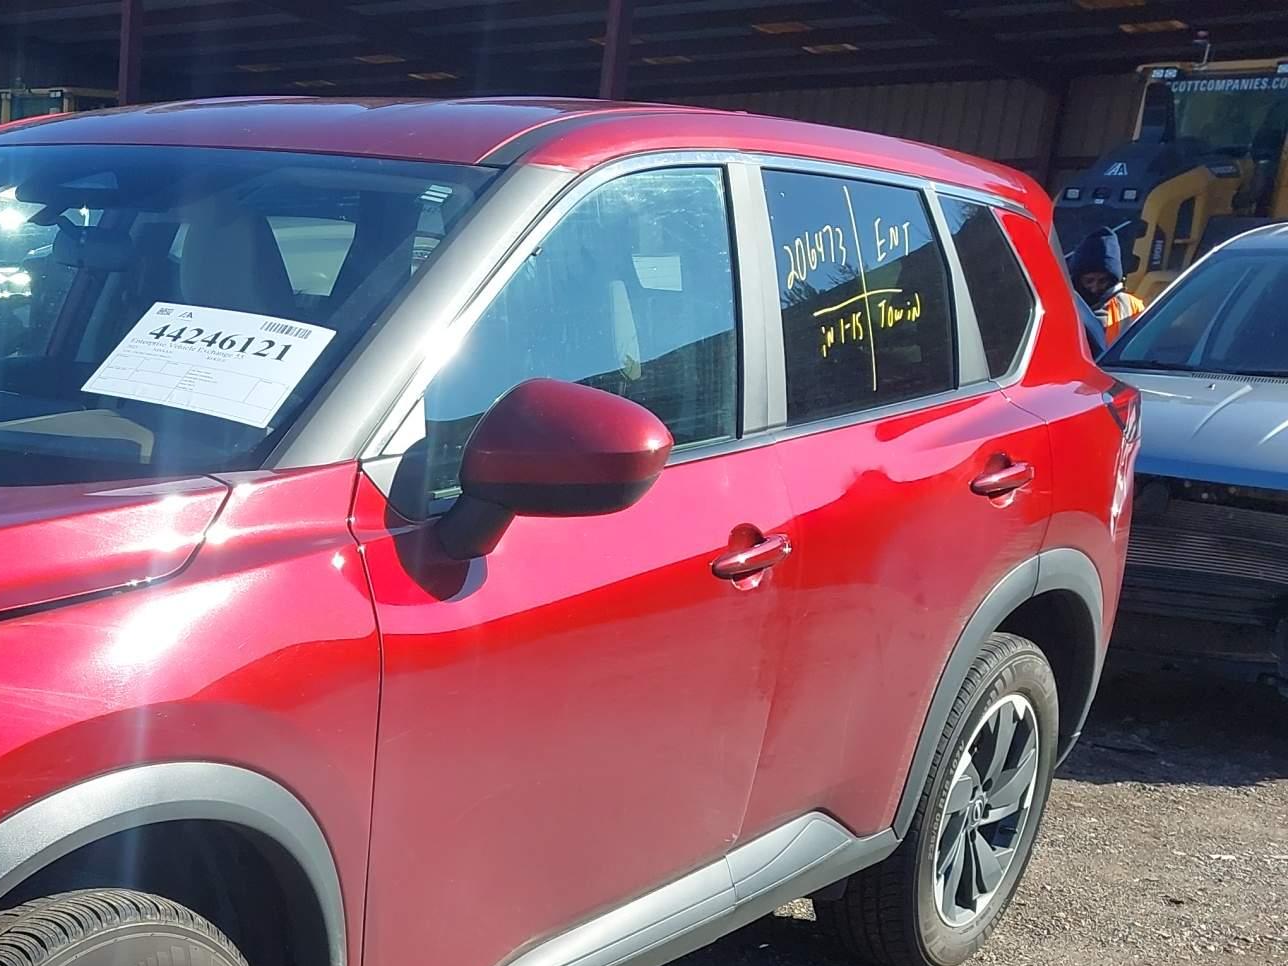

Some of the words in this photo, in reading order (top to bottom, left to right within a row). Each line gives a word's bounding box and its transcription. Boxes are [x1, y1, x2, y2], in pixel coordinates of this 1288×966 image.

[1165, 78, 1288, 93] COTTCOMPANIES.CO
[783, 224, 847, 290] 206473
[874, 217, 910, 262] ENT
[149, 324, 293, 362] 44246121
[840, 311, 864, 344] 1-15
